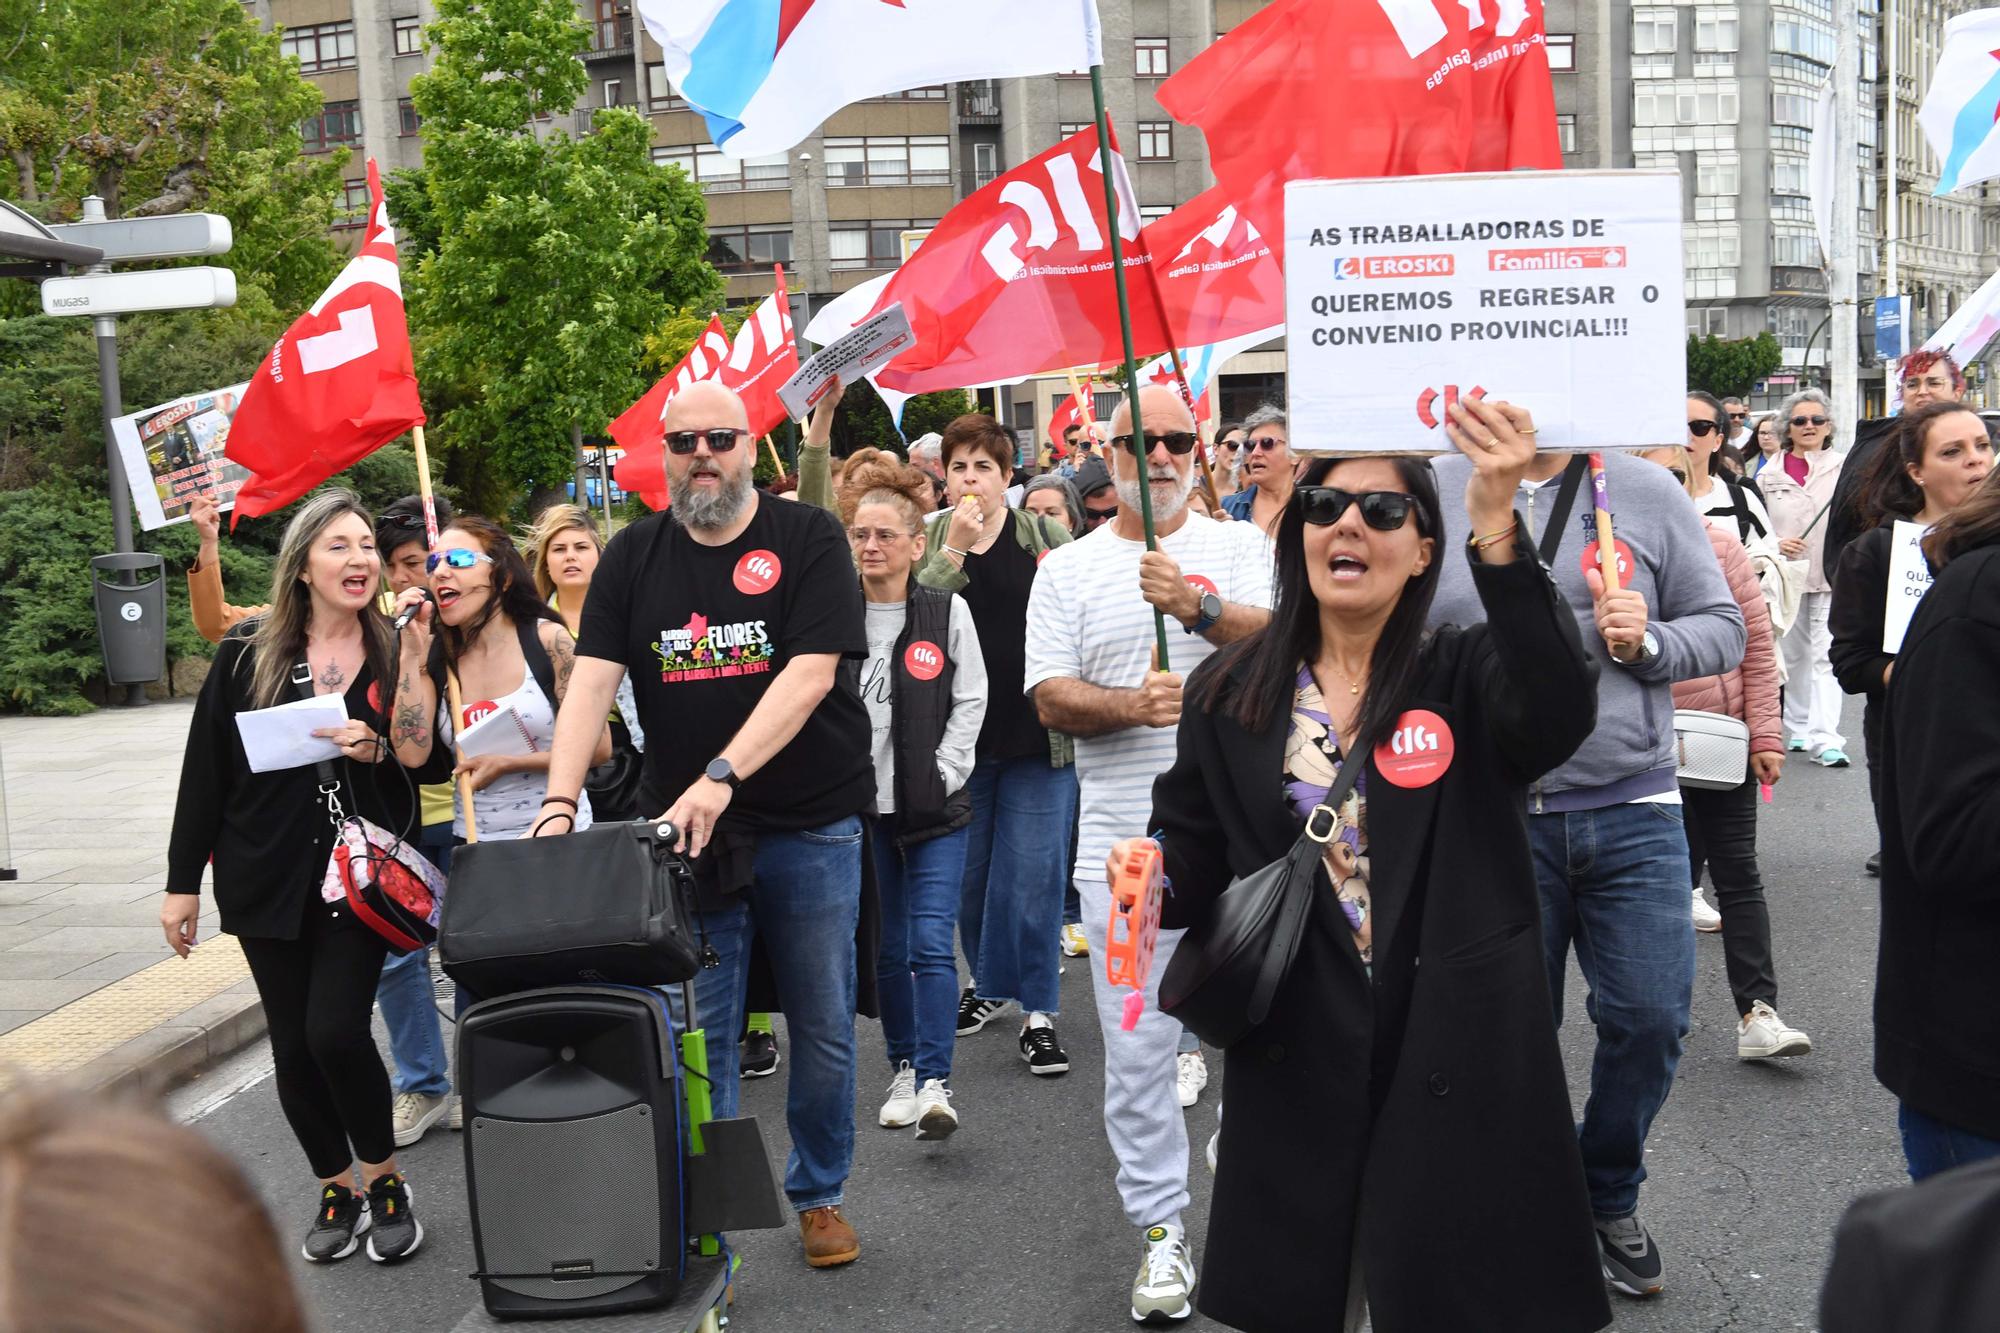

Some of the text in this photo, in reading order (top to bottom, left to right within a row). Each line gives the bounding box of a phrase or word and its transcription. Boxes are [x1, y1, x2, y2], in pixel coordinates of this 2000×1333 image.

[1309, 219, 1605, 247] AS TRABALLADORAS DE
[1369, 256, 1450, 275] EROSKI
[1311, 285, 1659, 317] QUEREMOS REGRESAR O
[1311, 317, 1628, 346] CONVENIO PROVINCIAL!!!
[1416, 385, 1488, 430] CI
[746, 556, 773, 579] CIG
[673, 640, 692, 651] DAS
[707, 620, 768, 649] FLORES
[914, 646, 936, 666] CIG
[1391, 725, 1438, 755] CIG
